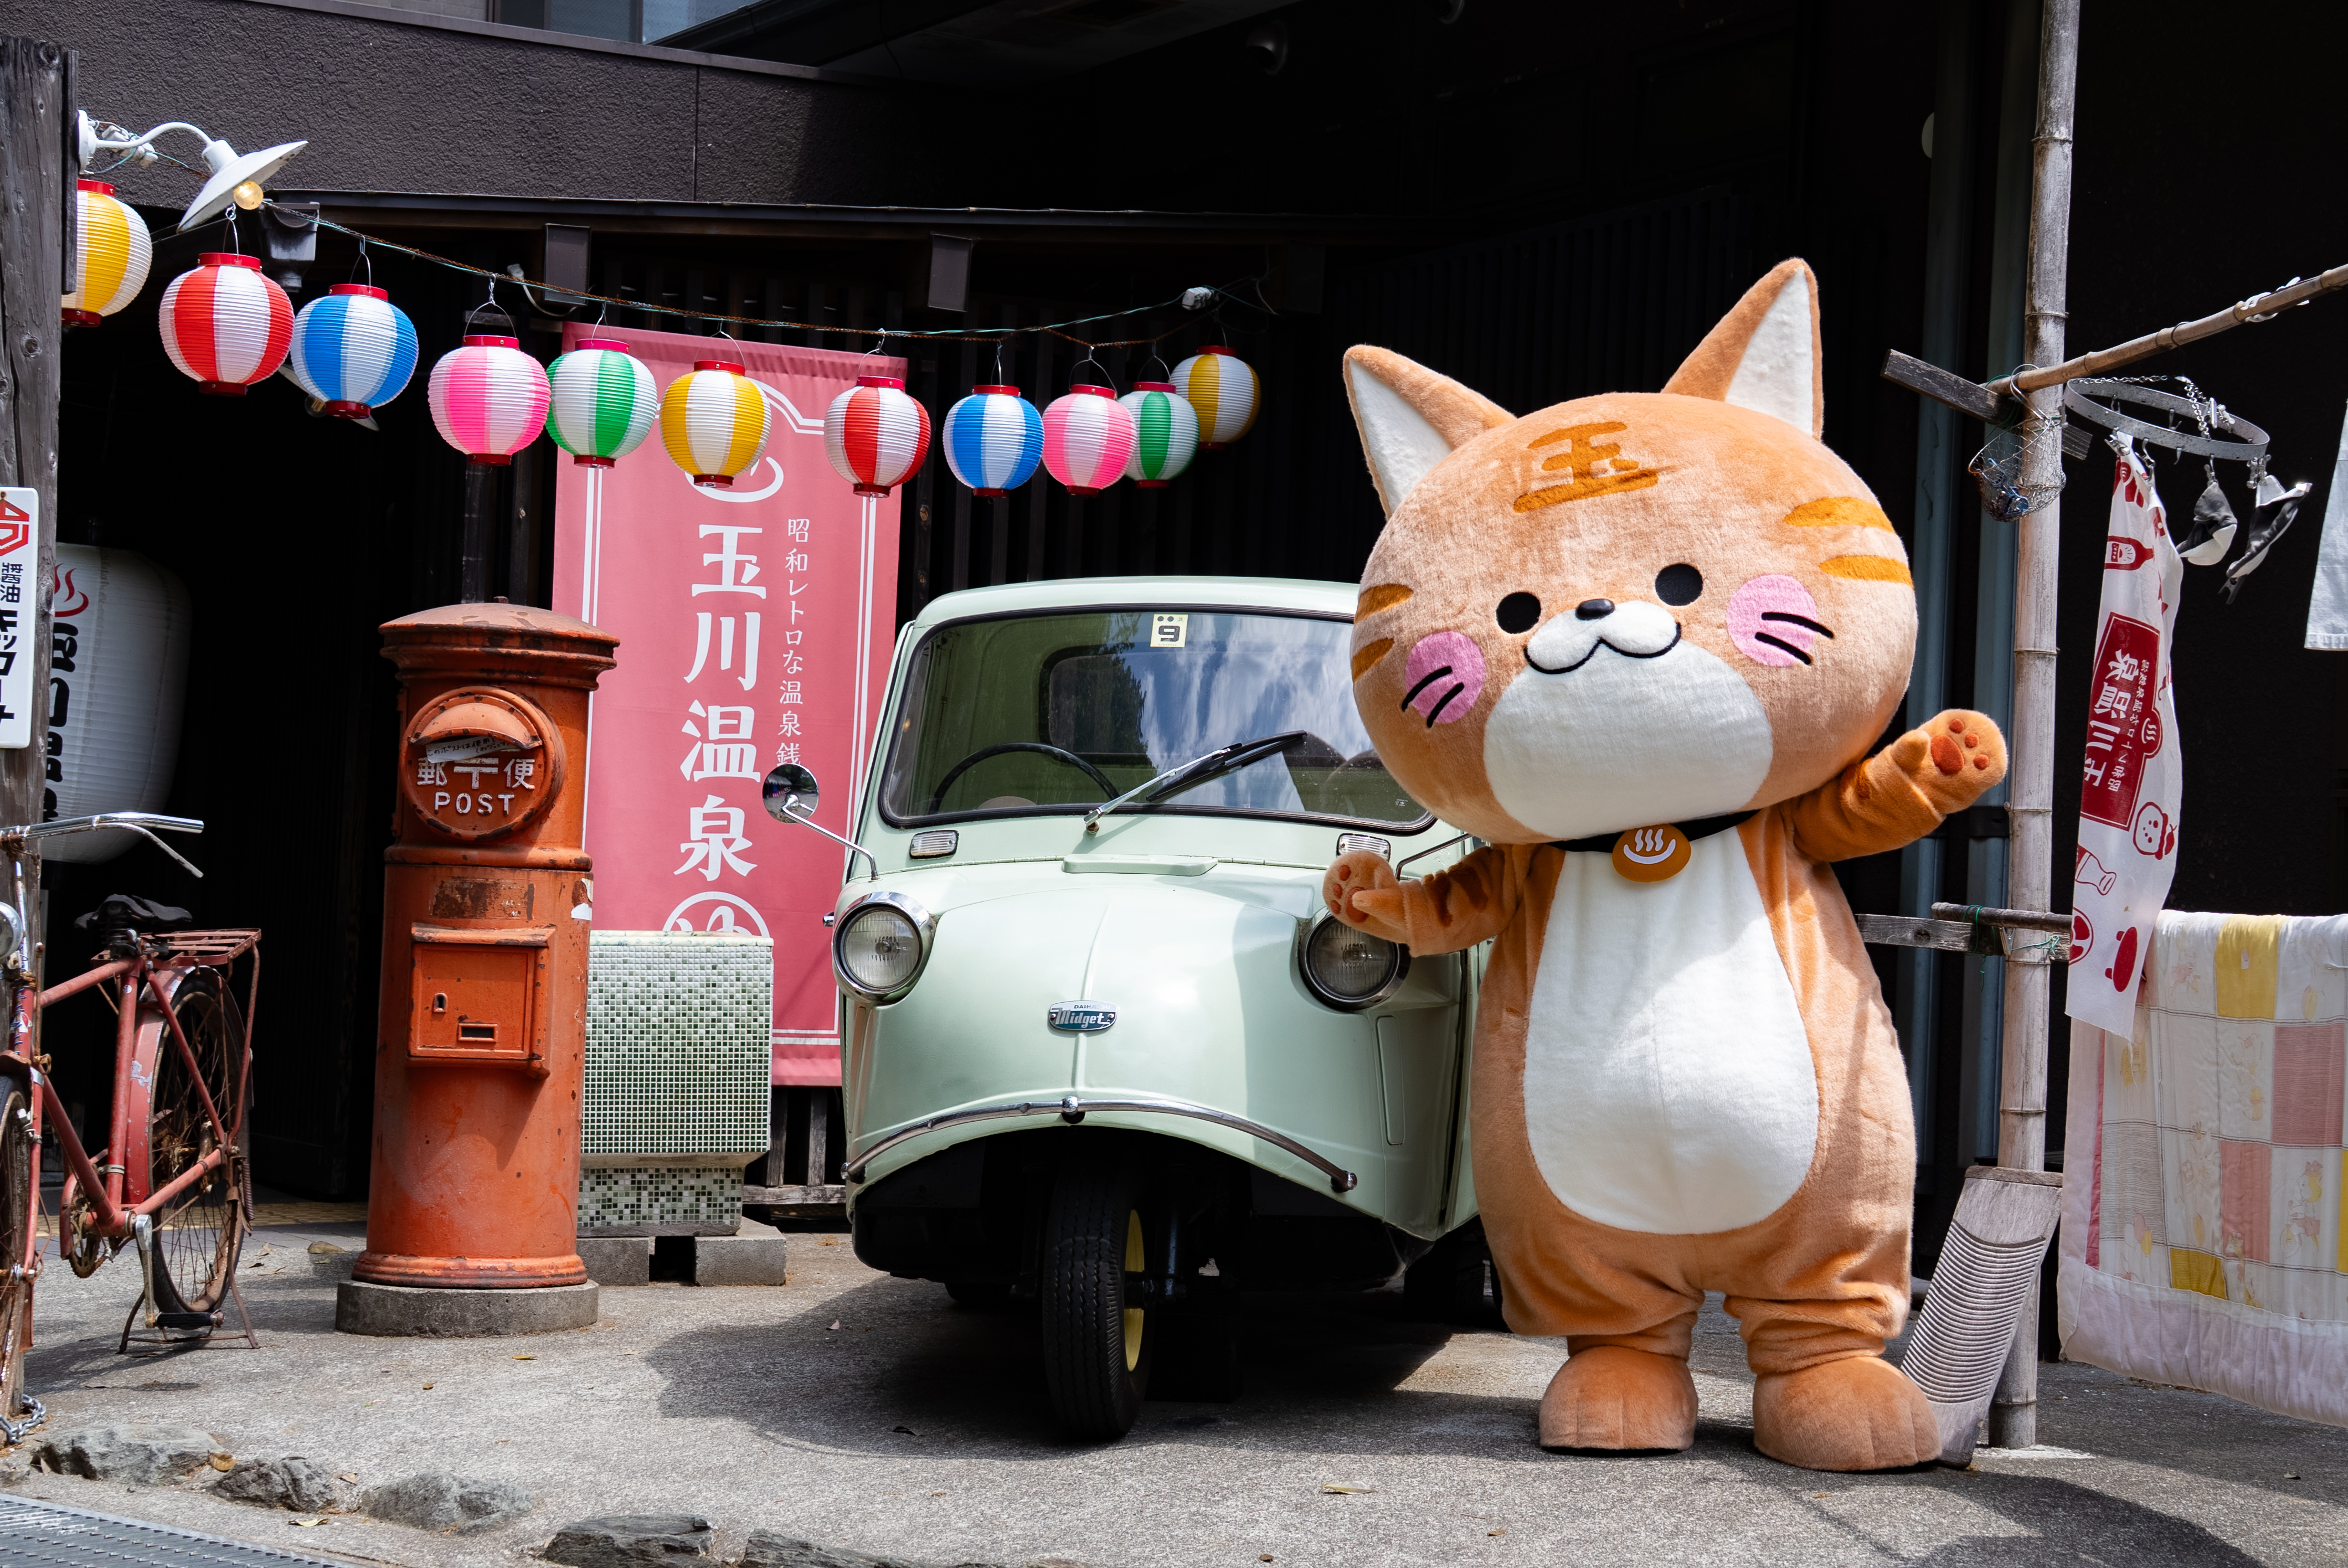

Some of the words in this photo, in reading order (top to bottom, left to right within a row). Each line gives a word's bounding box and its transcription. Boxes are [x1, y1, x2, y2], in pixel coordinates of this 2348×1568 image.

[1513, 421, 1659, 513] 玉
[1158, 625, 1181, 642] 9
[673, 524, 767, 881] 玉川温泉
[434, 792, 515, 817] POST
[1051, 1007, 1110, 1028] Midget
